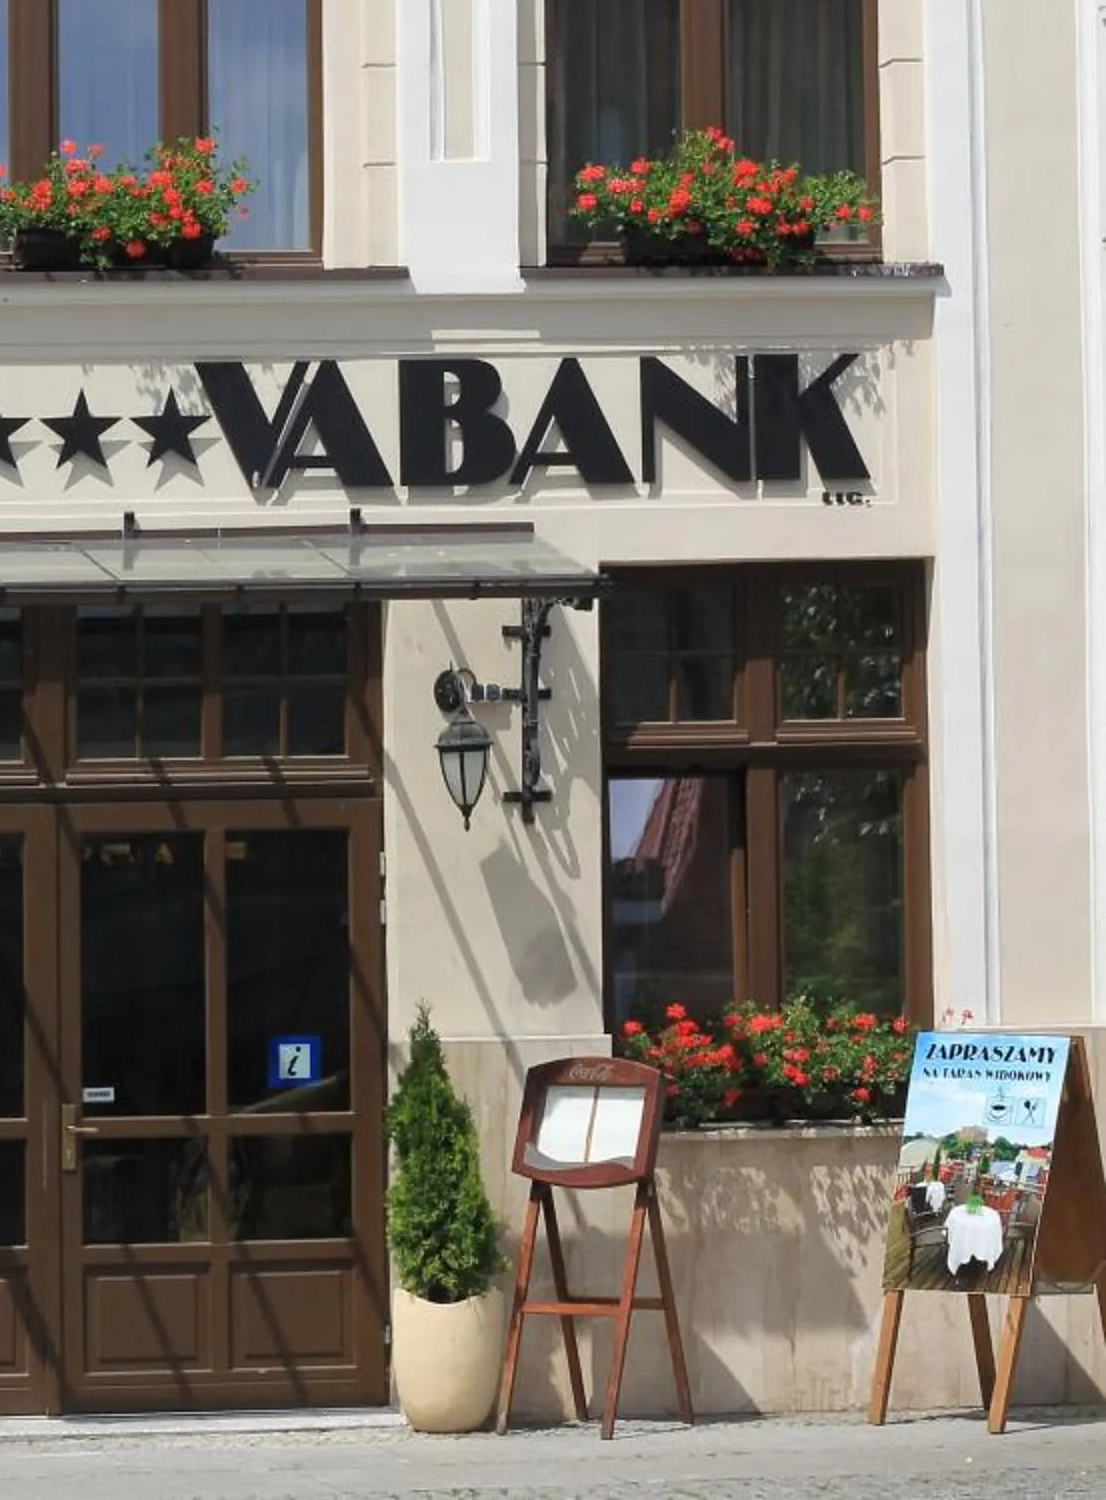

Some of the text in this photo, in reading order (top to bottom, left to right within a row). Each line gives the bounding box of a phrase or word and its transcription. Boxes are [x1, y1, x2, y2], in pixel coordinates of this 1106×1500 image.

[925, 1043, 1056, 1065] ZAPRASZAMY
[923, 1067, 939, 1078] NA
[985, 1069, 1051, 1083] WIDOKOWY
